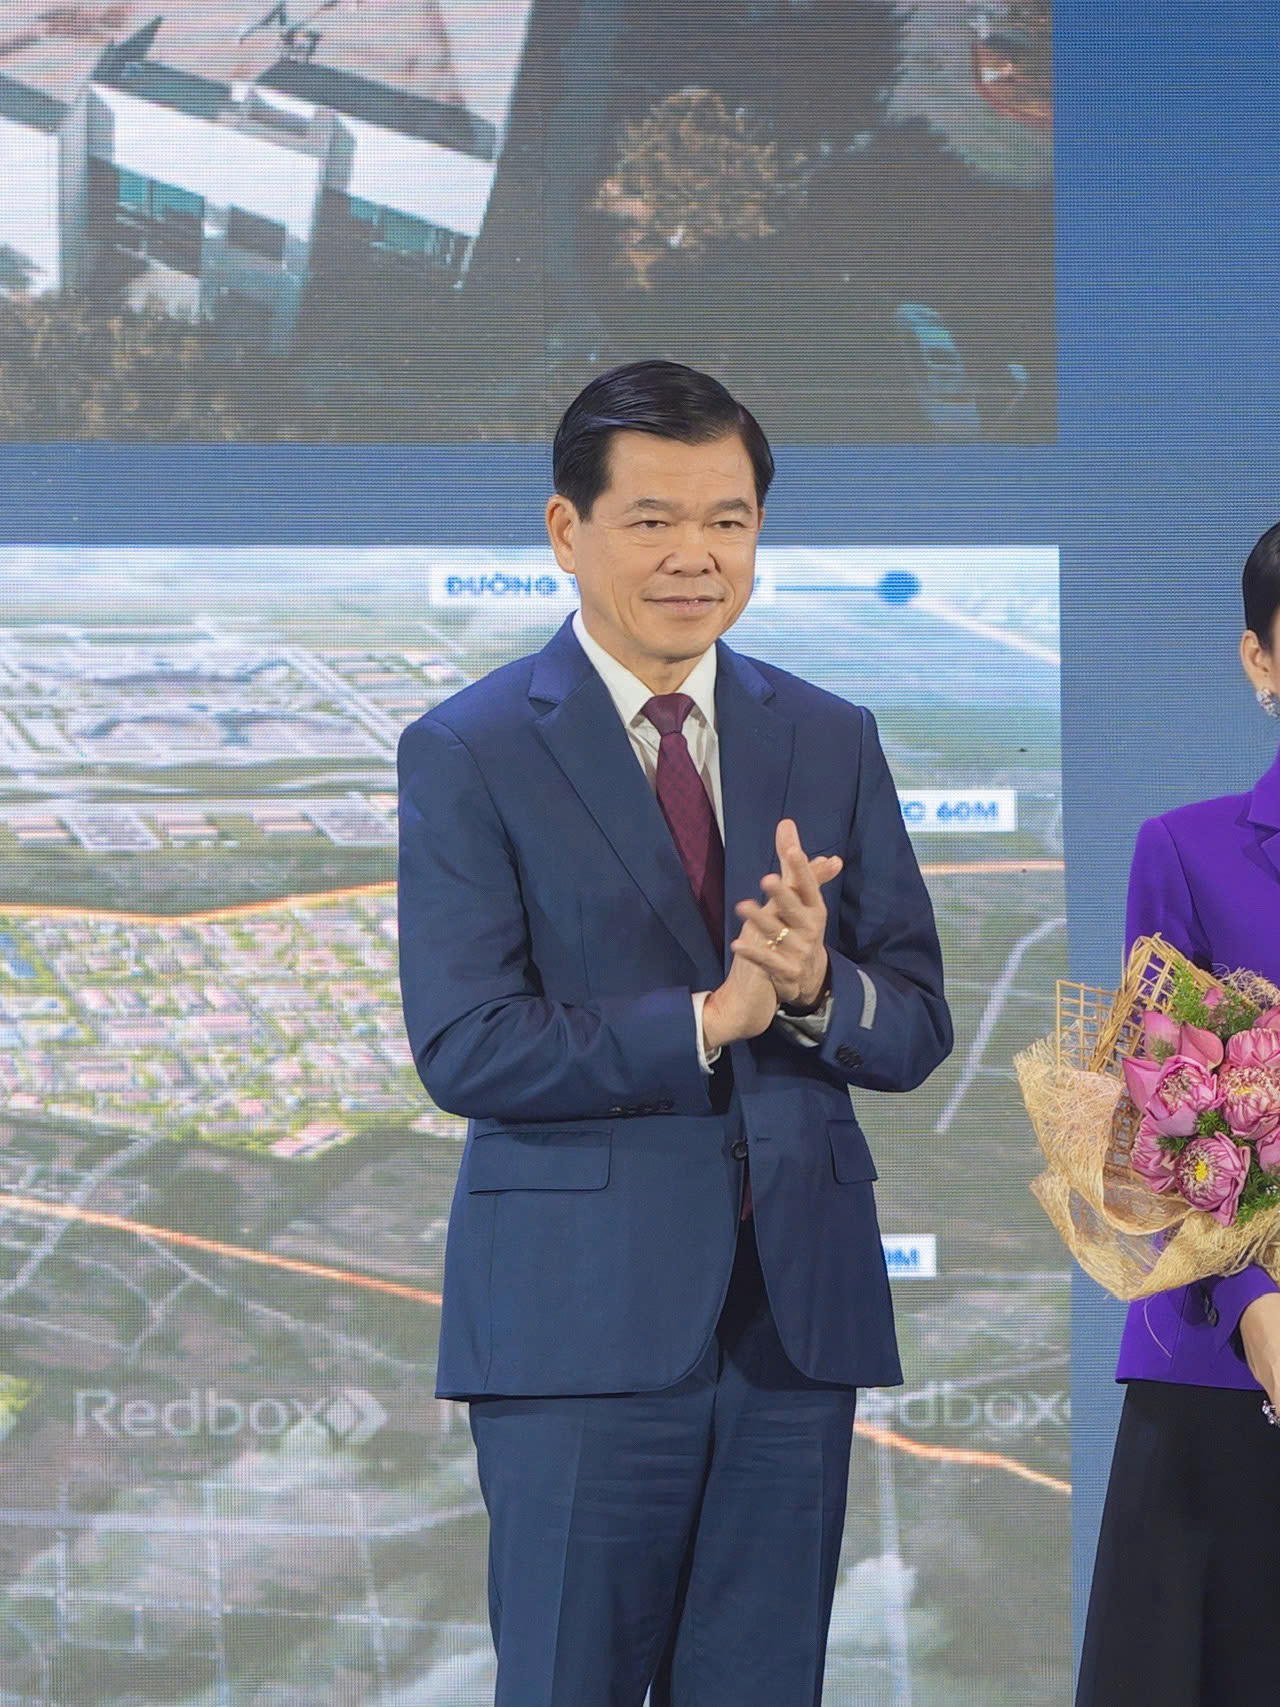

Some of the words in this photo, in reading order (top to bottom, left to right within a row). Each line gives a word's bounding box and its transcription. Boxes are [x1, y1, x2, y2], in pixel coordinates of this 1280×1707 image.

[936, 801, 998, 823] 60M
[74, 1387, 328, 1438] Redbox
[857, 1381, 1063, 1428] edbox
